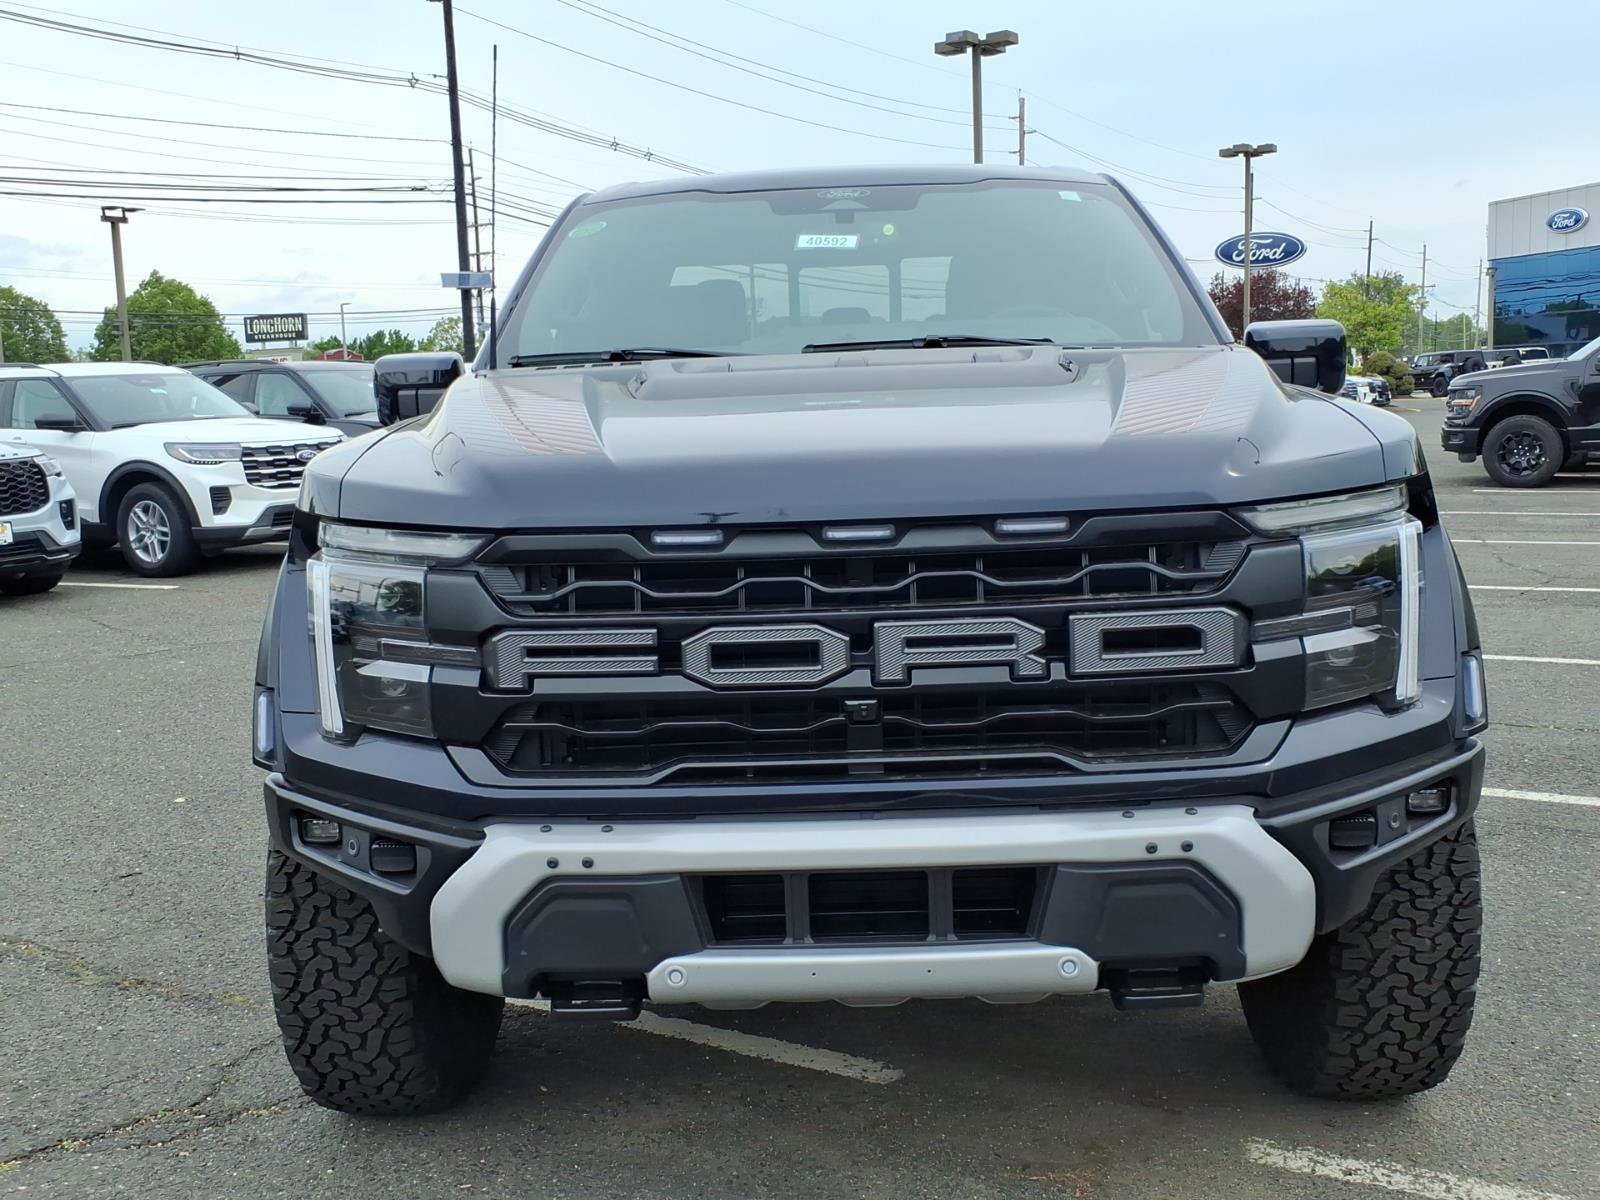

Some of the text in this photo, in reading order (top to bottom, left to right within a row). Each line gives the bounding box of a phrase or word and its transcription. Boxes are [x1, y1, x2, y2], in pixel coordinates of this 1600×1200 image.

[1552, 213, 1576, 229] Ford
[806, 236, 848, 247] 40592
[1232, 238, 1287, 262] Ford
[246, 317, 303, 335] LONGHORN
[484, 606, 1249, 691] FORD
